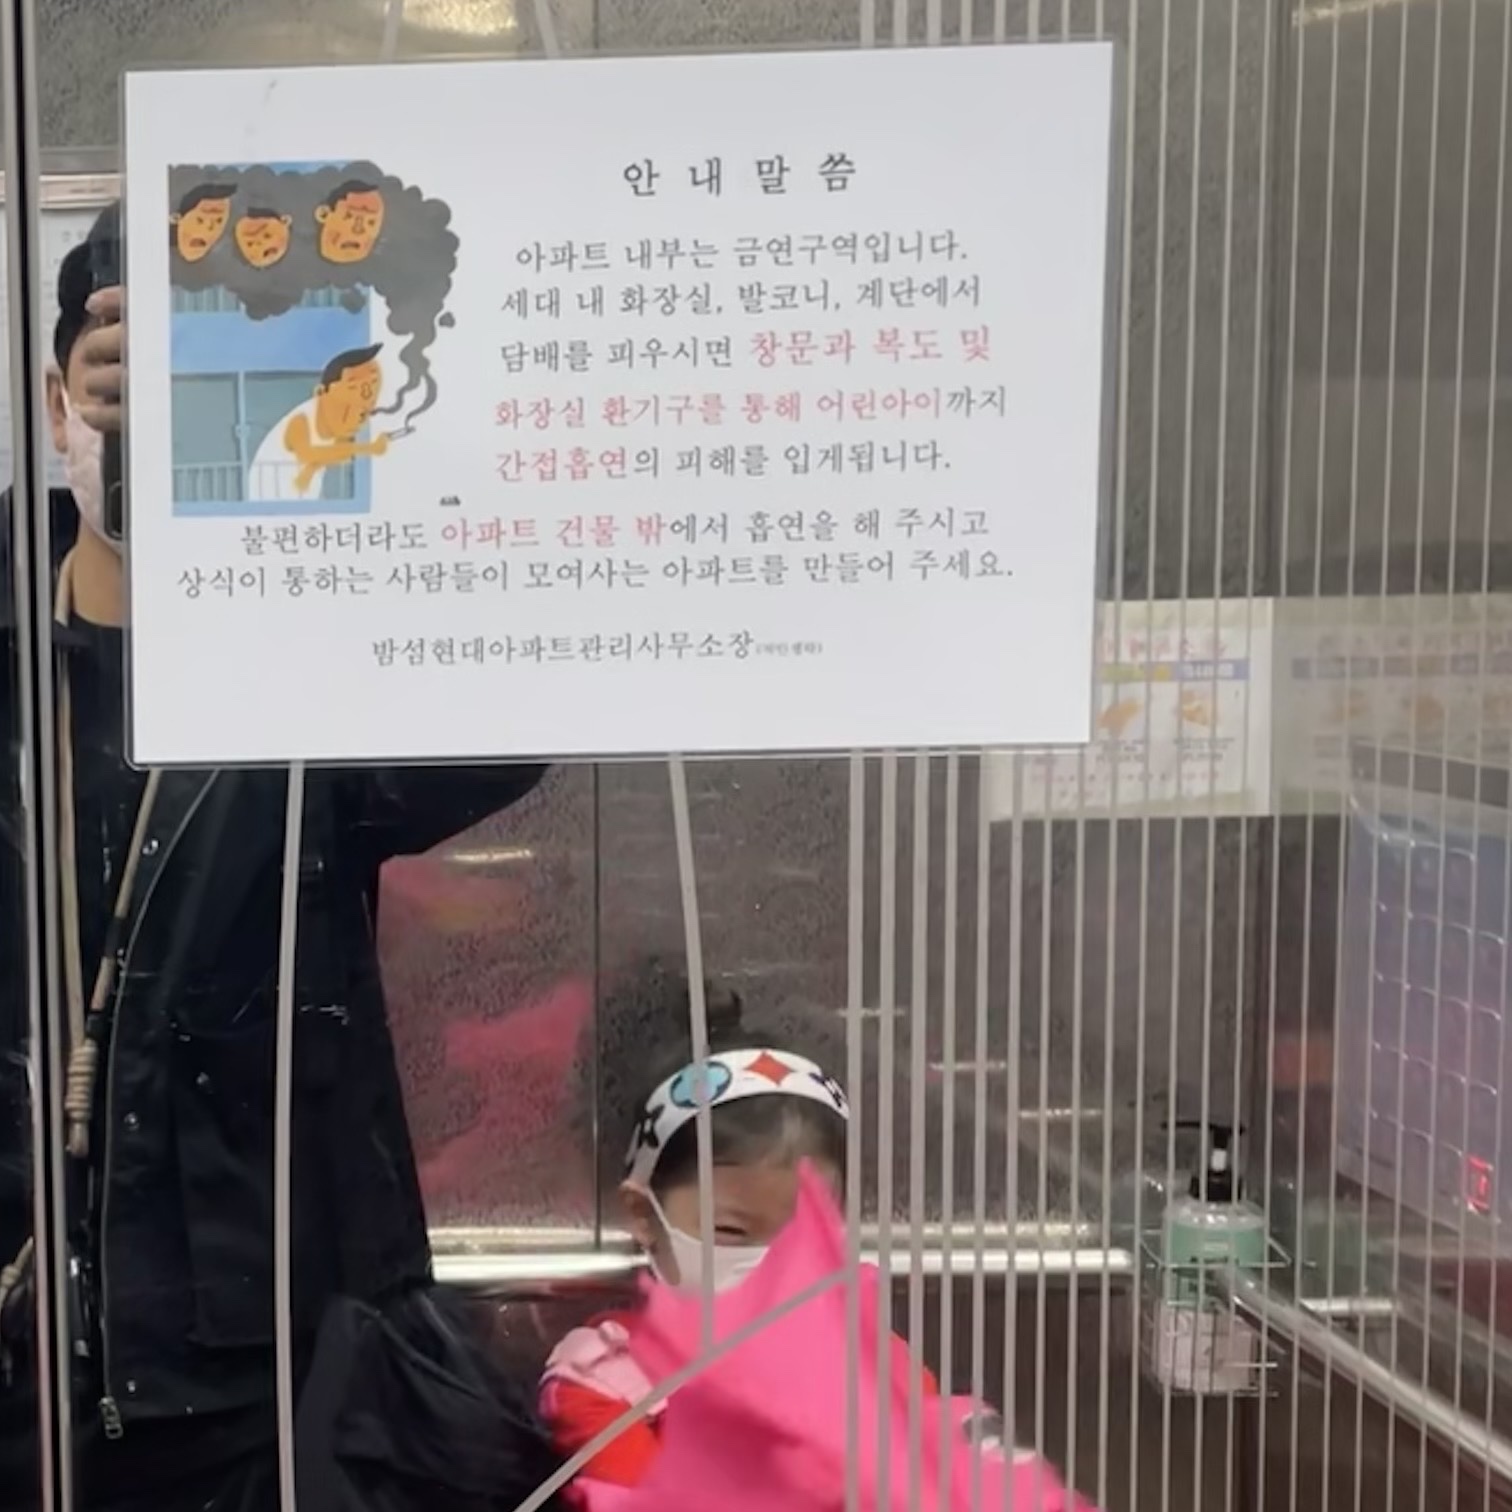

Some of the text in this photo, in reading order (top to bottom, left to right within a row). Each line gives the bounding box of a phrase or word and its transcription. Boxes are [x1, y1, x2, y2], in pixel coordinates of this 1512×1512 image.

[516, 229, 967, 273] 아파트 내부는 금연구역입니다.
[501, 274, 980, 319] 세대 내 화장실, 발코니, 계단에서
[500, 325, 989, 373] 담배를 피우시면 창문과 복도 및
[495, 385, 1005, 430] 화장실 환기구를 통해 어린아이까지
[495, 439, 951, 482] 간접흡연의 피해를 입게됩니다.
[241, 506, 988, 556] 불편하더라도 아파트 건물 밖에서 흡연을 해 주시고
[178, 549, 1013, 599] 상식이 통하는 사람들이 모여사는 아파트를 만들어 주세요.
